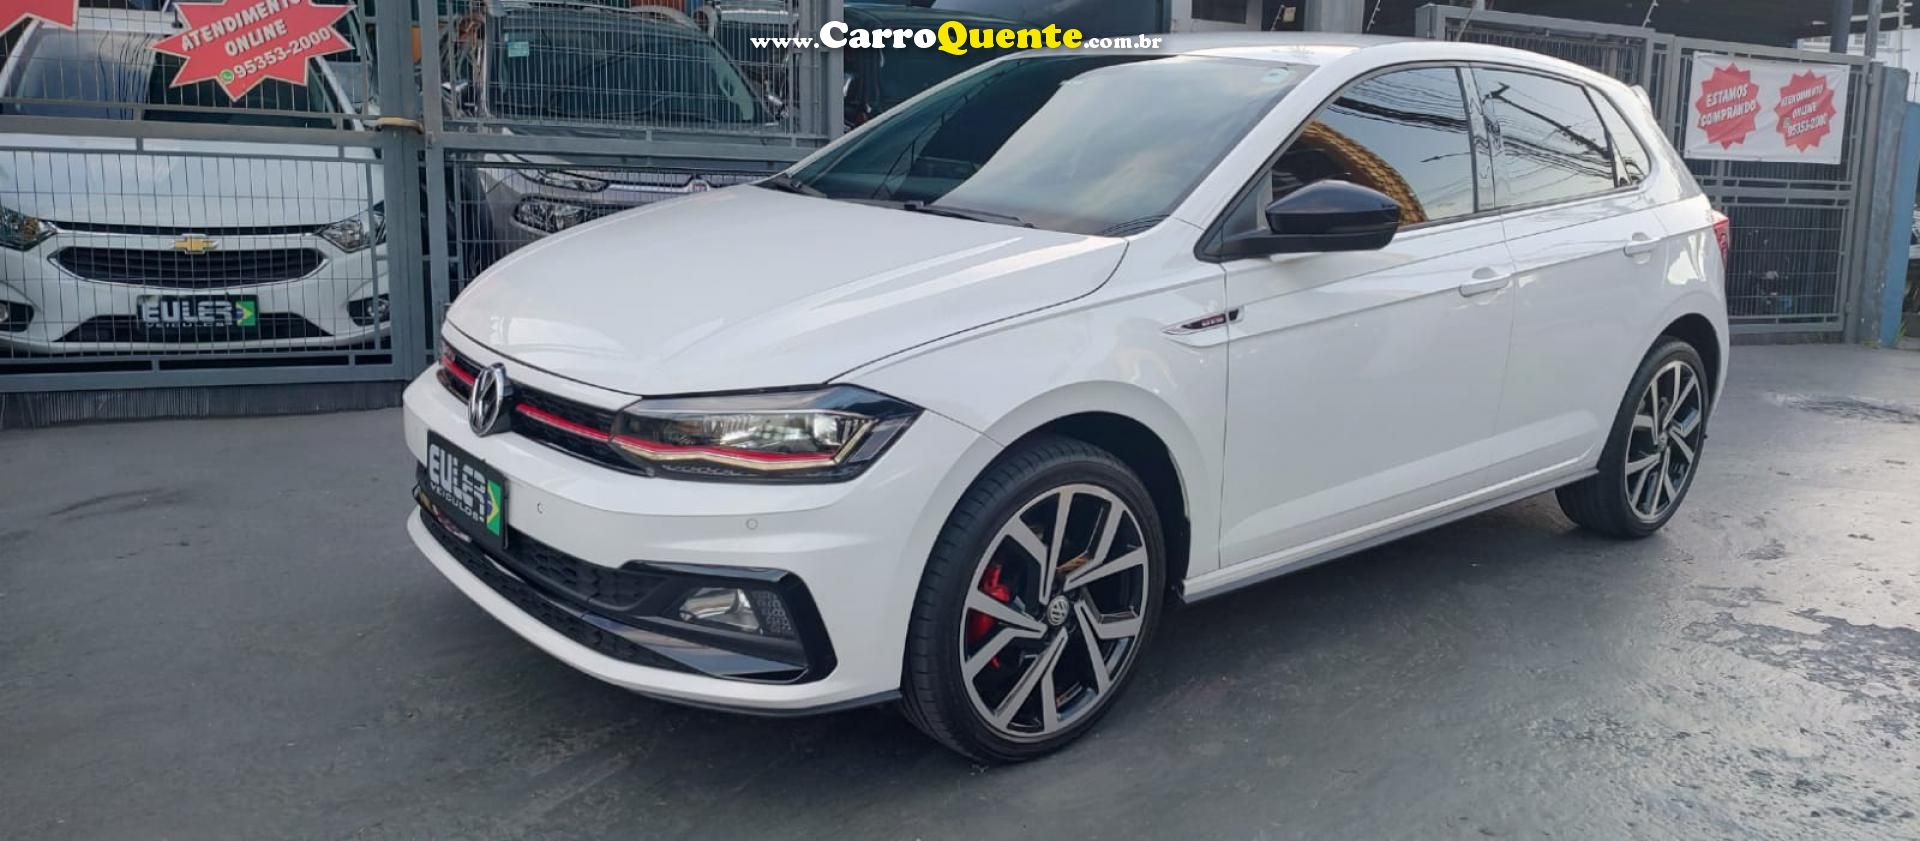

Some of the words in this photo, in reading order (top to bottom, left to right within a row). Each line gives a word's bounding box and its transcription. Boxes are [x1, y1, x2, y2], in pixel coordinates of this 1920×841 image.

[224, 19, 288, 57] ONLINE
[233, 27, 331, 78] 95353-2000
[1706, 83, 1748, 107] ESTAMOS
[1701, 100, 1756, 126] COMPRANDO
[142, 301, 233, 325] EULER
[429, 443, 486, 523] EULER
